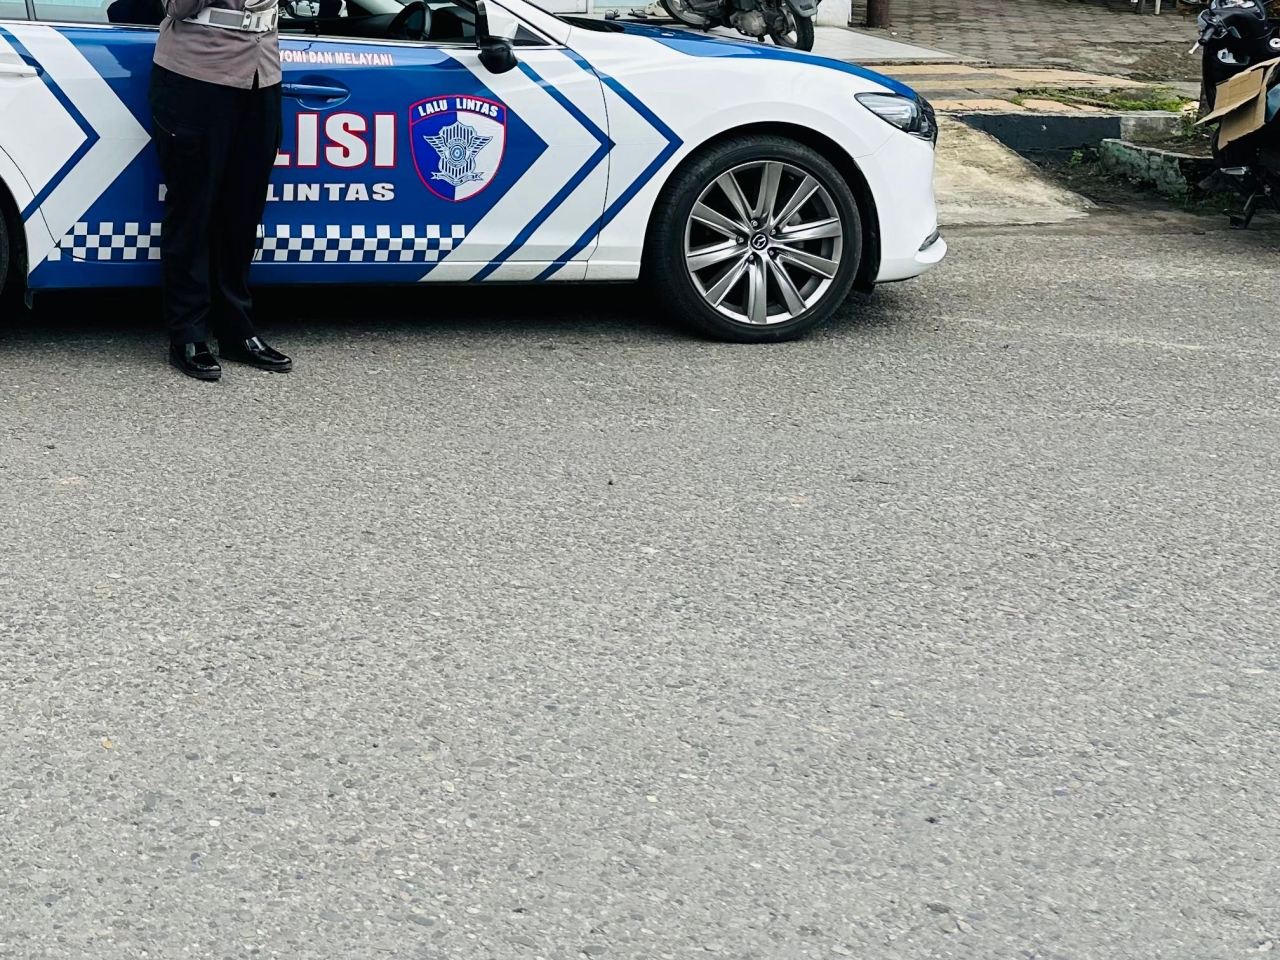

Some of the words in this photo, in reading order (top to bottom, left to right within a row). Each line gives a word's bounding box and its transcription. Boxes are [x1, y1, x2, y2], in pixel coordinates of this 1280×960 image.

[308, 51, 332, 64] DAN
[334, 52, 394, 66] MELAYANI
[418, 100, 448, 117] LALU
[456, 98, 498, 117] LINTAS
